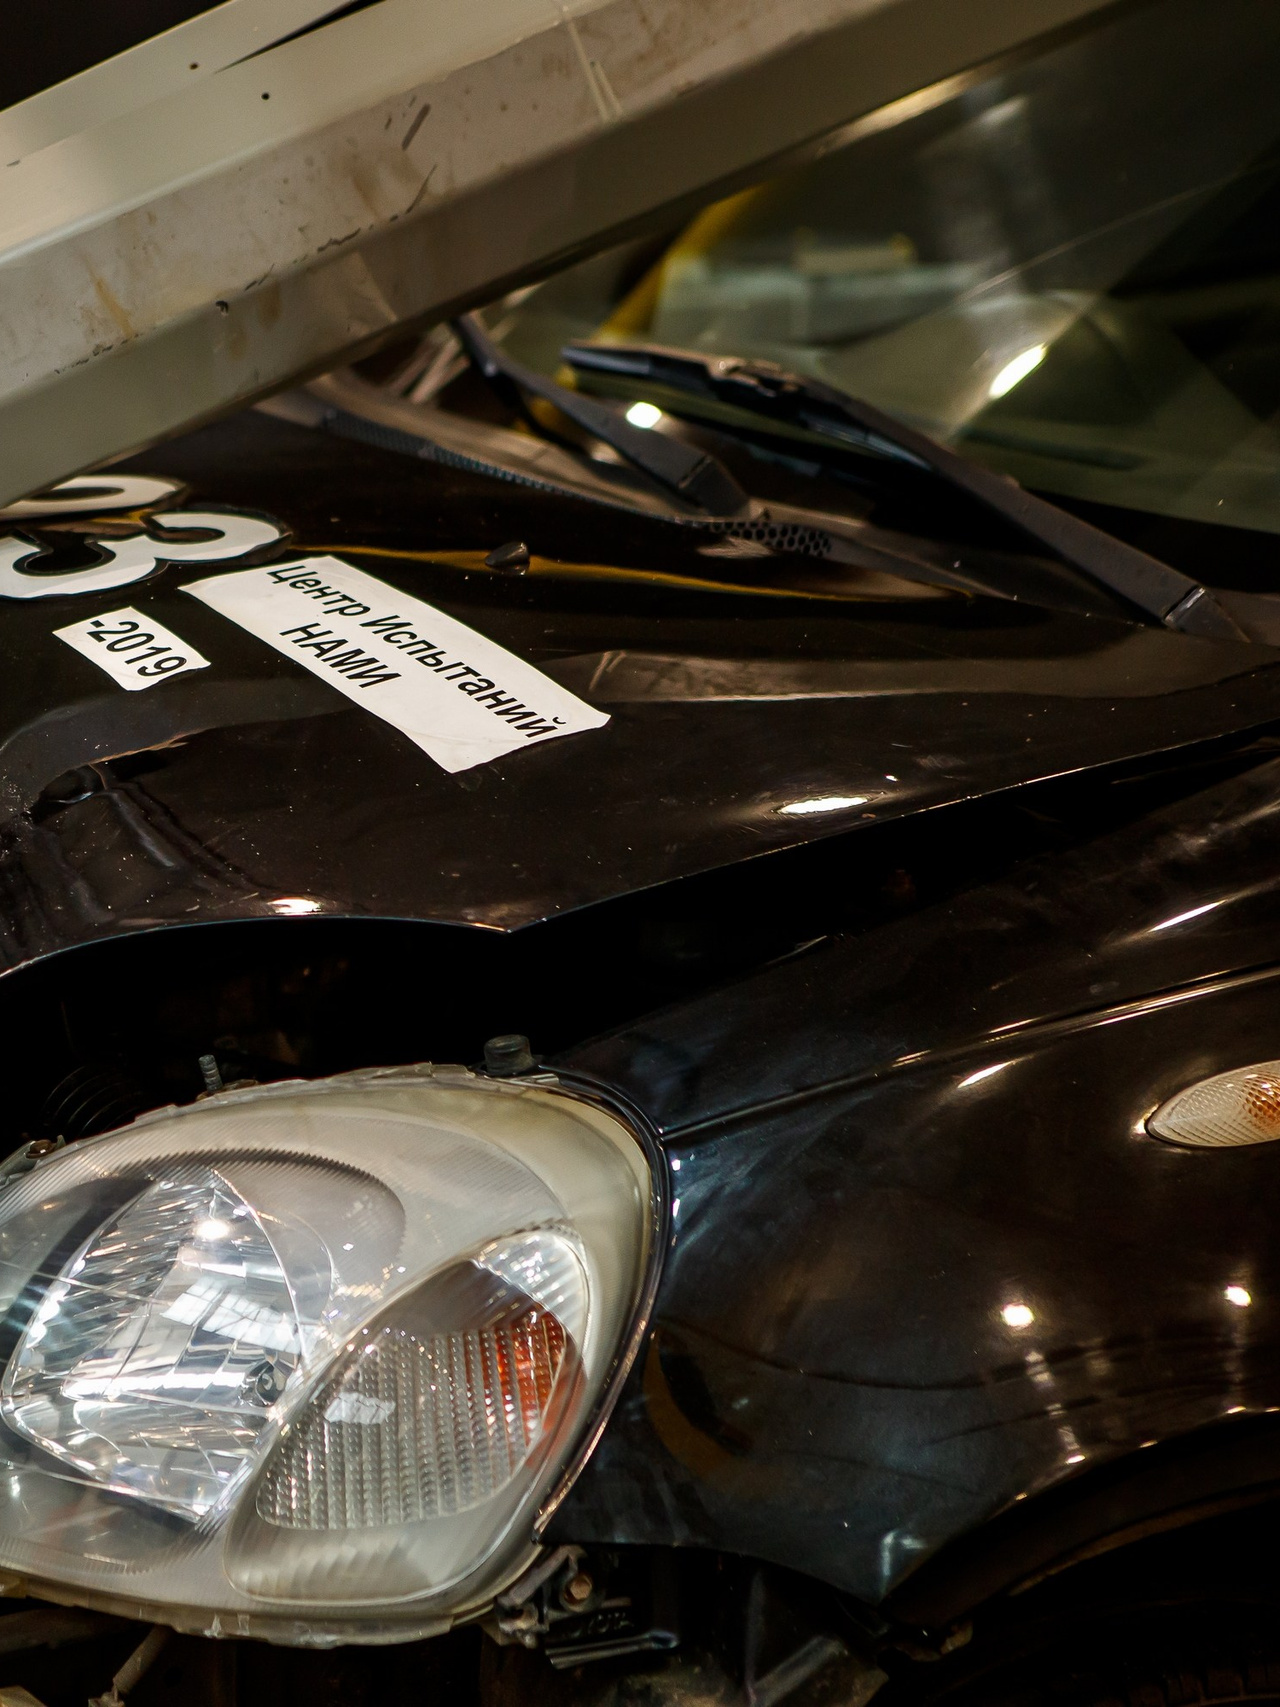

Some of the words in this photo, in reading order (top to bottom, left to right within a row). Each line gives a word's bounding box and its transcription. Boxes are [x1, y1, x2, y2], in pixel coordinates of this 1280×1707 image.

[86, 619, 187, 677] -2019
[267, 565, 371, 616] Центр
[359, 615, 567, 738] Испытаний
[279, 622, 402, 688] НАМИ
